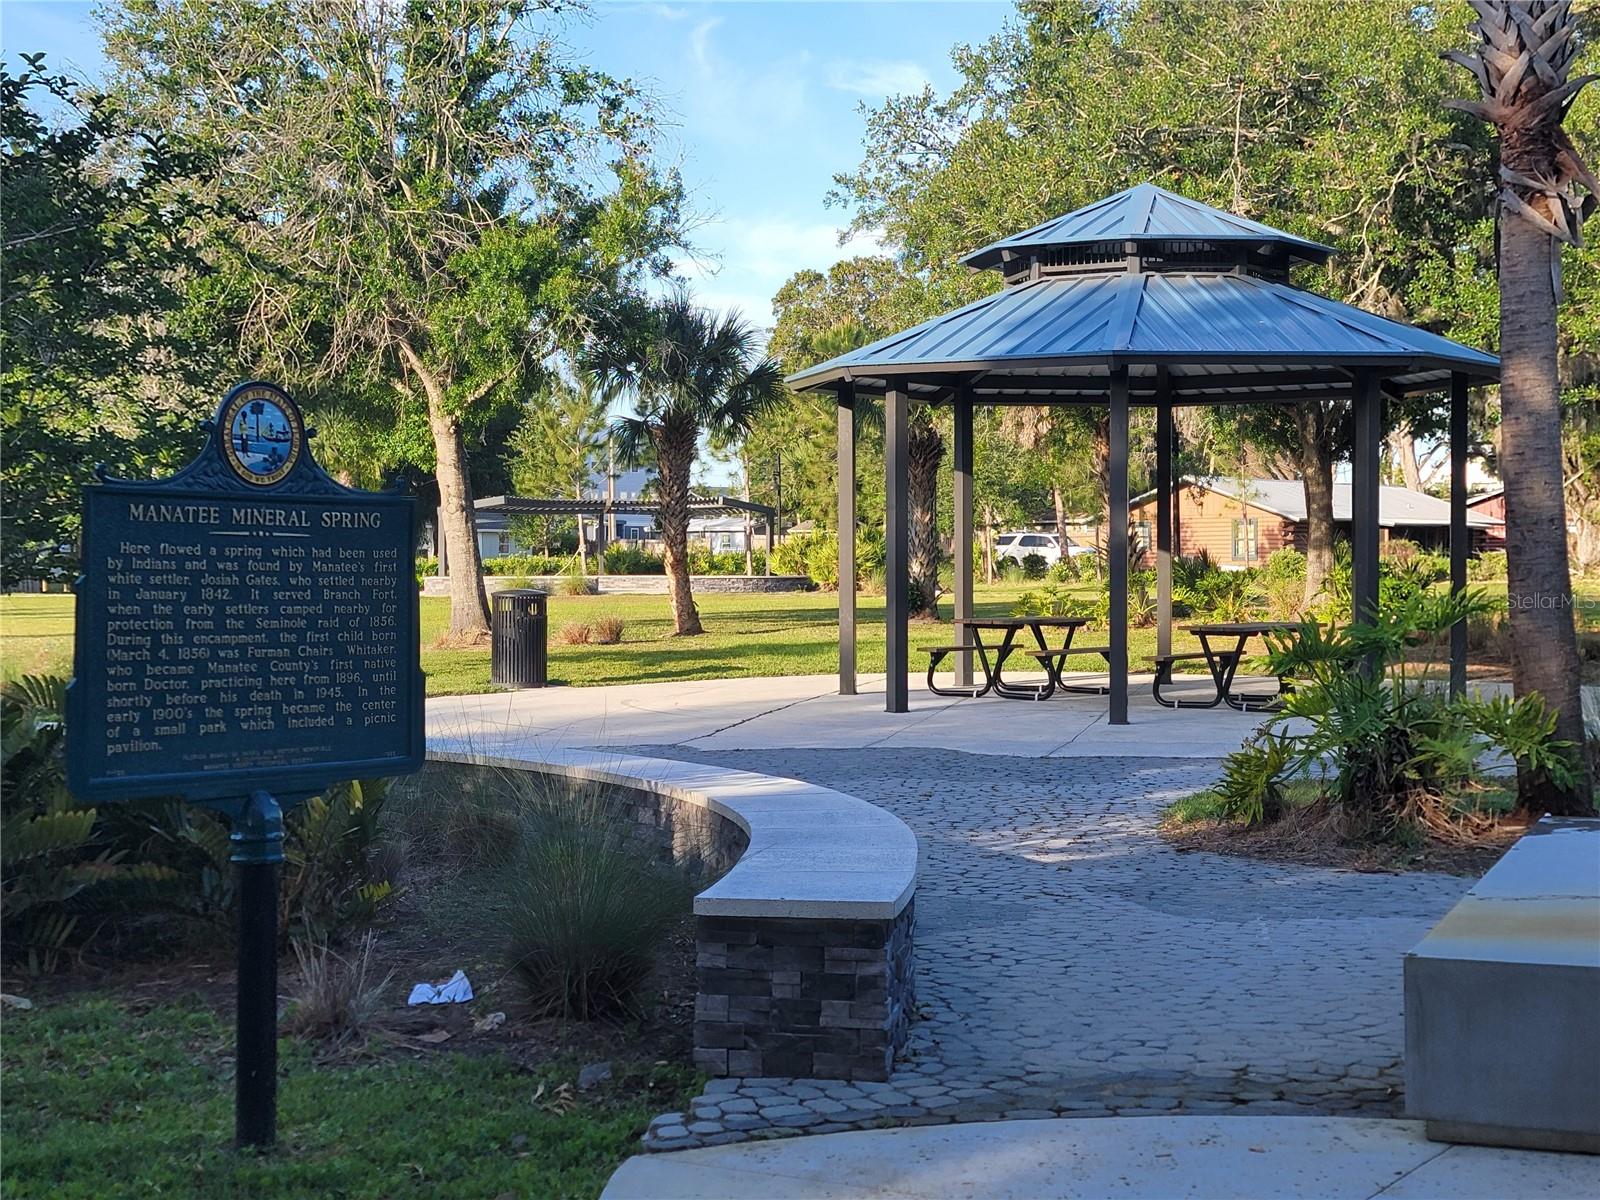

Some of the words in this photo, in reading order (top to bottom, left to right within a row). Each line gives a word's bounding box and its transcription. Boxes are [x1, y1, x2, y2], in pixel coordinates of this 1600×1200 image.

[129, 504, 220, 524] MANATEE
[232, 508, 310, 527] MINERAL
[321, 512, 381, 528] SPRING
[120, 542, 150, 554] Here
[160, 543, 201, 555] flowed
[209, 547, 216, 556] a
[224, 545, 262, 558] spring
[272, 546, 304, 557] which
[312, 548, 331, 558] had
[340, 548, 365, 558] been
[373, 548, 397, 558] used
[108, 557, 123, 570] by
[132, 558, 176, 569] Indians
[185, 559, 206, 570] and
[217, 562, 238, 570] was
[248, 560, 279, 571] found
[290, 561, 303, 573] by
[313, 562, 365, 572] Manatee's
[374, 562, 397, 572] first
[108, 573, 142, 584] white
[201, 574, 239, 585] Josiah
[290, 576, 311, 585] who
[319, 576, 354, 586] settled
[361, 576, 397, 587] nearby
[108, 588, 120, 599] in
[136, 588, 186, 602] January
[251, 589, 259, 599] It
[273, 590, 311, 600] served
[324, 589, 360, 599] Branch
[108, 604, 141, 614] when
[153, 604, 172, 614] the
[184, 604, 214, 616] early
[225, 604, 269, 614] settlers
[280, 604, 322, 615] camped
[335, 604, 370, 615] nearby
[382, 604, 397, 613] for
[108, 619, 173, 632] protection
[186, 619, 214, 629] from
[225, 619, 244, 629] the
[256, 618, 306, 629] Seminole
[318, 618, 339, 628] raid
[349, 617, 360, 627] of
[107, 634, 151, 648] During
[161, 634, 183, 644] this
[280, 632, 297, 642] the
[307, 632, 329, 642] first
[338, 631, 363, 641] child
[372, 631, 396, 640] born
[218, 649, 239, 658] was
[248, 647, 290, 658] Furman
[298, 646, 333, 656] Chairs
[107, 665, 132, 675] who
[146, 664, 194, 675] became
[270, 660, 318, 672] County's
[330, 659, 353, 670] first
[364, 659, 396, 669] native
[107, 680, 136, 691] born
[201, 676, 262, 690] practicing
[270, 675, 296, 685] here
[304, 674, 329, 685] from
[373, 671, 396, 682] until
[107, 694, 152, 708] shortly
[166, 693, 208, 705] before
[220, 691, 238, 703] his
[250, 690, 282, 701] death
[294, 689, 304, 699] in
[358, 686, 368, 696] In
[380, 686, 396, 696] the
[107, 711, 140, 723] early
[153, 707, 192, 720] 1900's
[205, 707, 224, 718] the
[234, 706, 272, 718] spring
[282, 703, 325, 714] became
[335, 701, 352, 711] the
[362, 700, 396, 710] center
[107, 727, 120, 738] of
[133, 728, 140, 736] a
[154, 723, 186, 735] small
[200, 722, 226, 735] park
[240, 720, 274, 730] which
[288, 716, 334, 728] included
[347, 717, 352, 725] a
[364, 713, 396, 726] picnic
[107, 740, 162, 755] pavilion.
